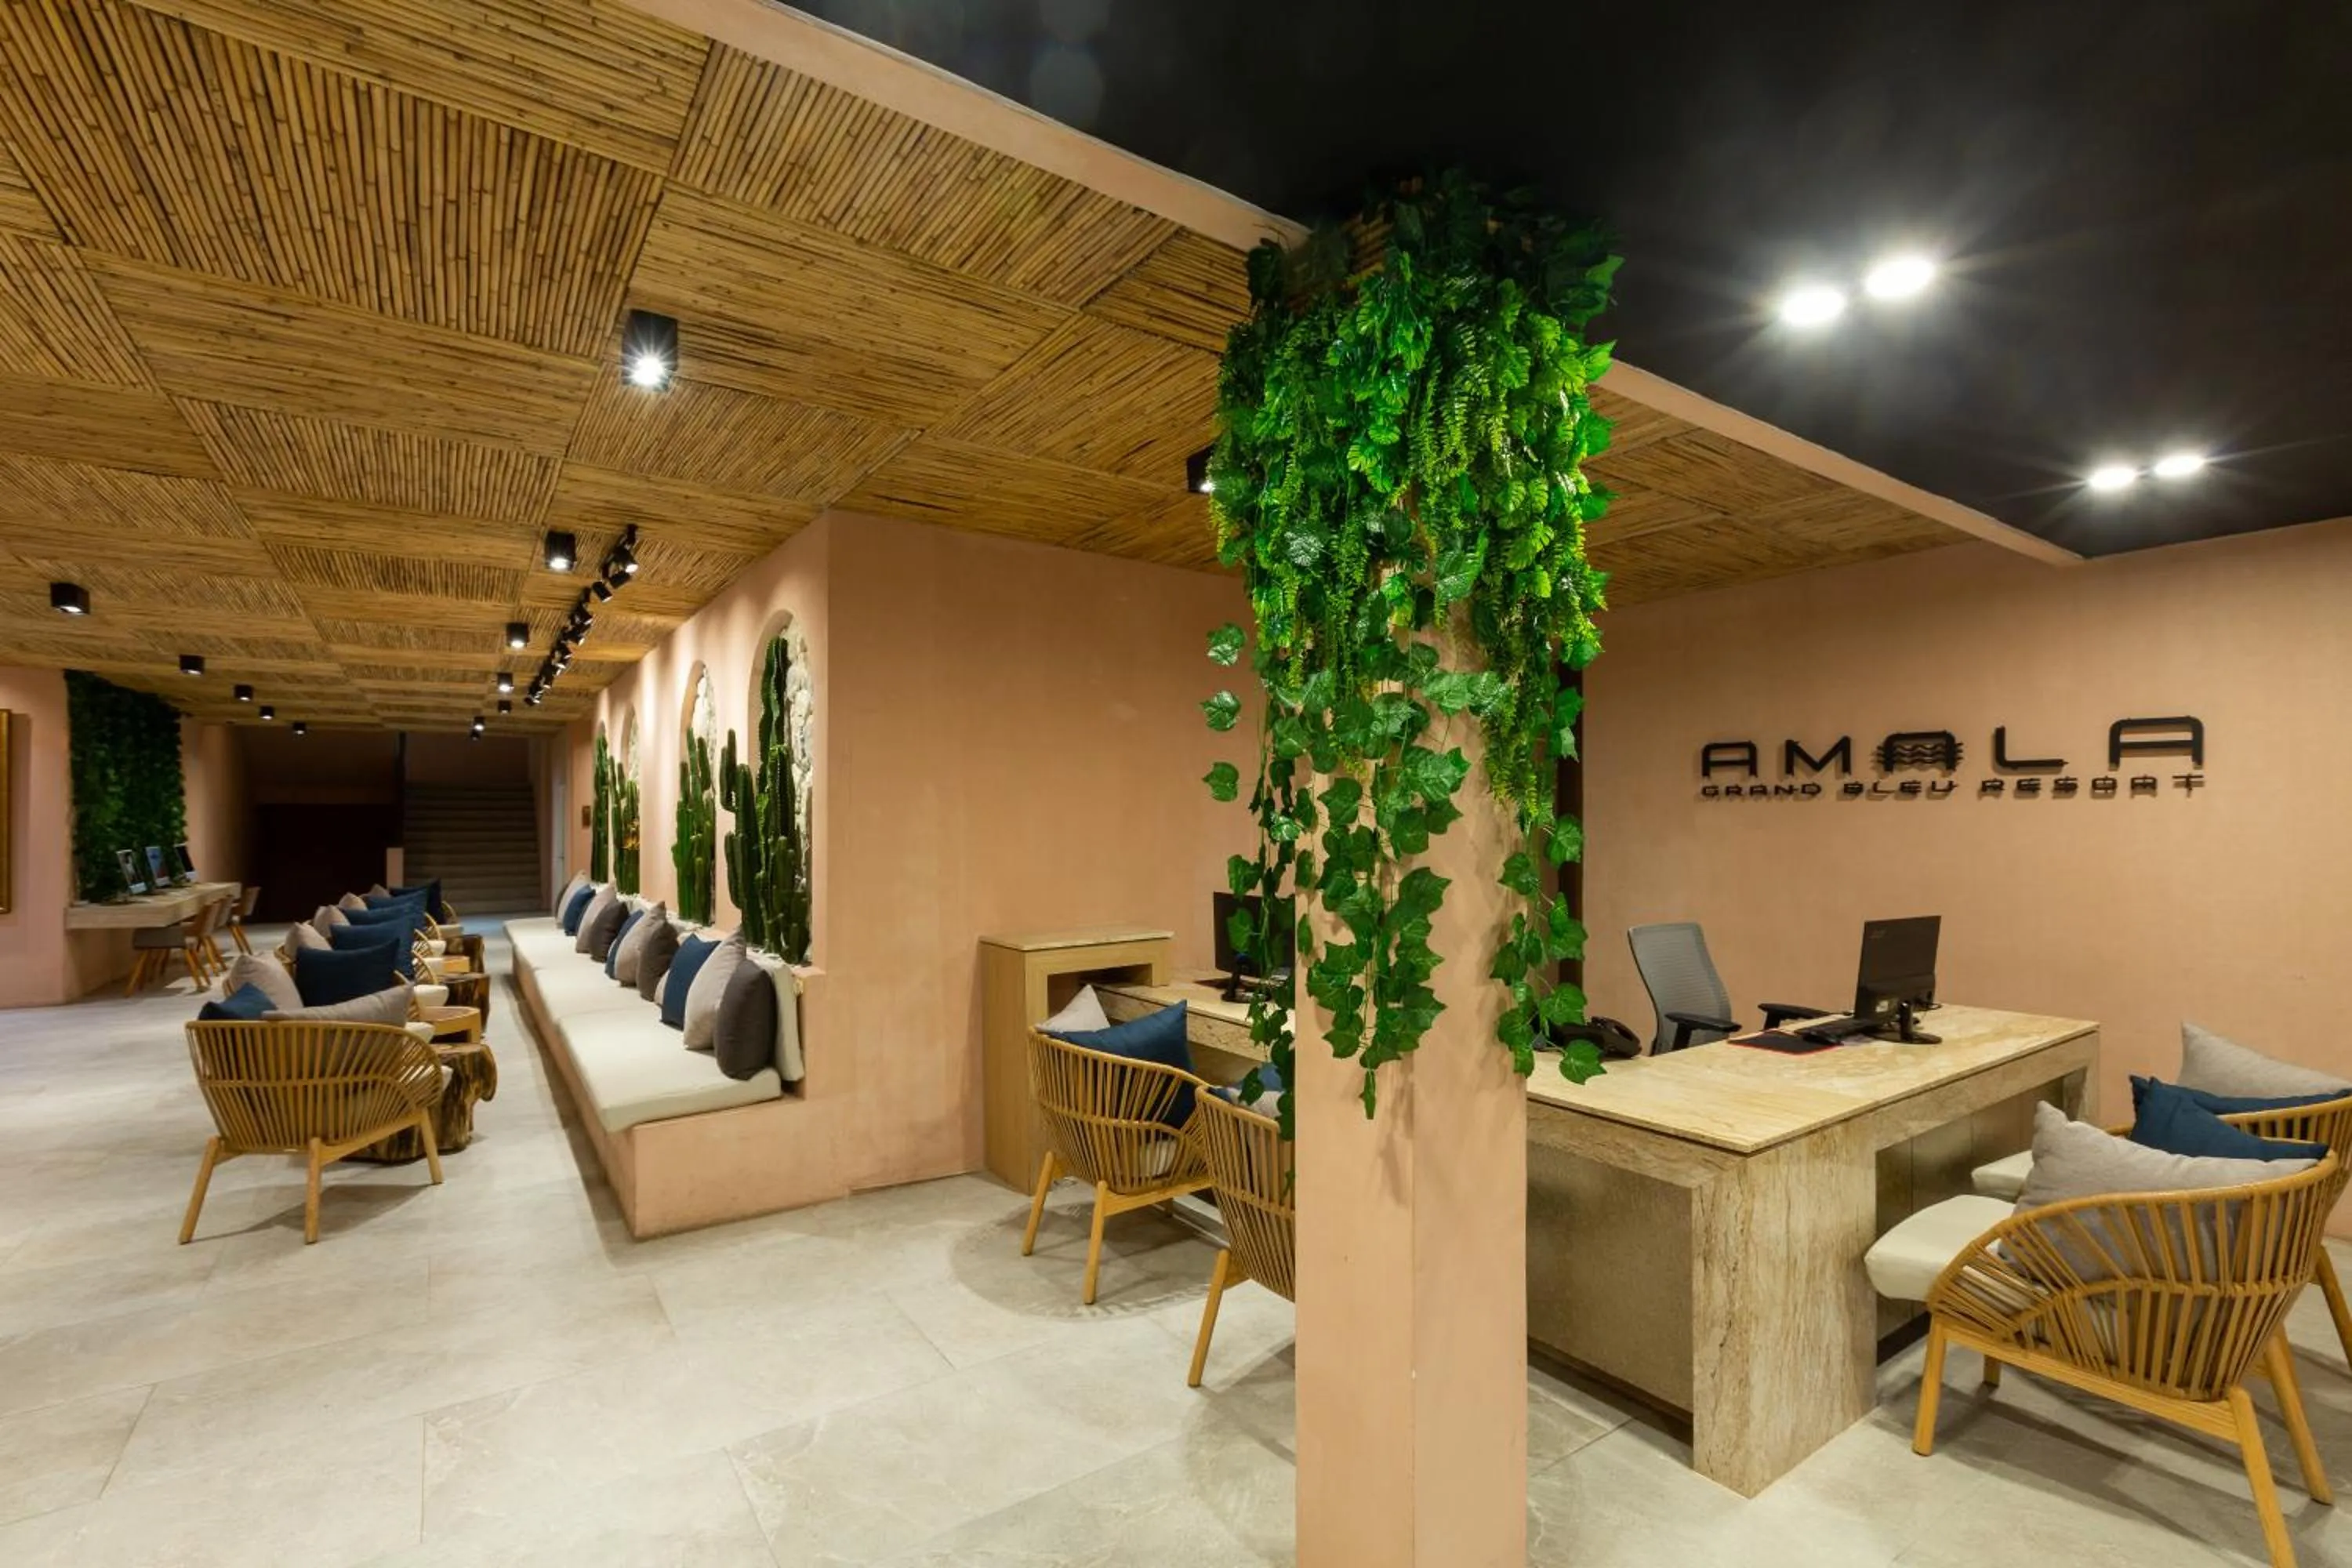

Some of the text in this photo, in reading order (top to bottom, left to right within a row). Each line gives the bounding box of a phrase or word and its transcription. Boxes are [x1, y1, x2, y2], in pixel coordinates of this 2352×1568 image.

[1701, 715, 2205, 779] AMALA
[1701, 774, 2205, 797] GRAND BLEU RESORT
